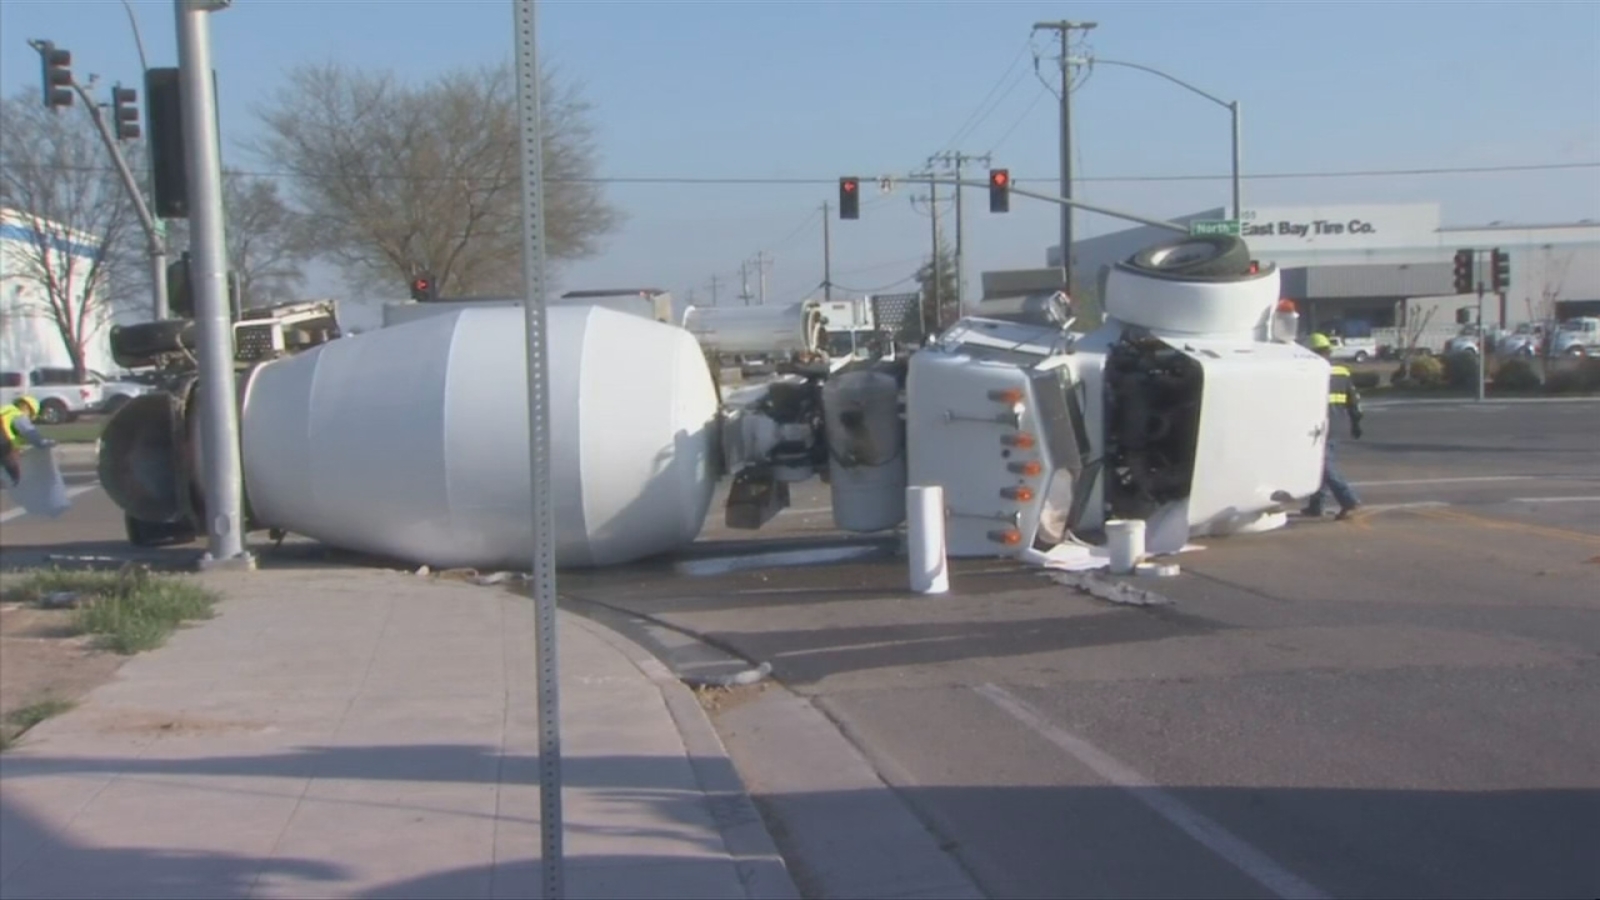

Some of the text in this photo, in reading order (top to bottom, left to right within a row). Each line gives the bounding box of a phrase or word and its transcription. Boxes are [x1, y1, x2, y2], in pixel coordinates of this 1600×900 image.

[1197, 223, 1229, 234] North
[1241, 219, 1376, 237] East Bay Tire Co.
